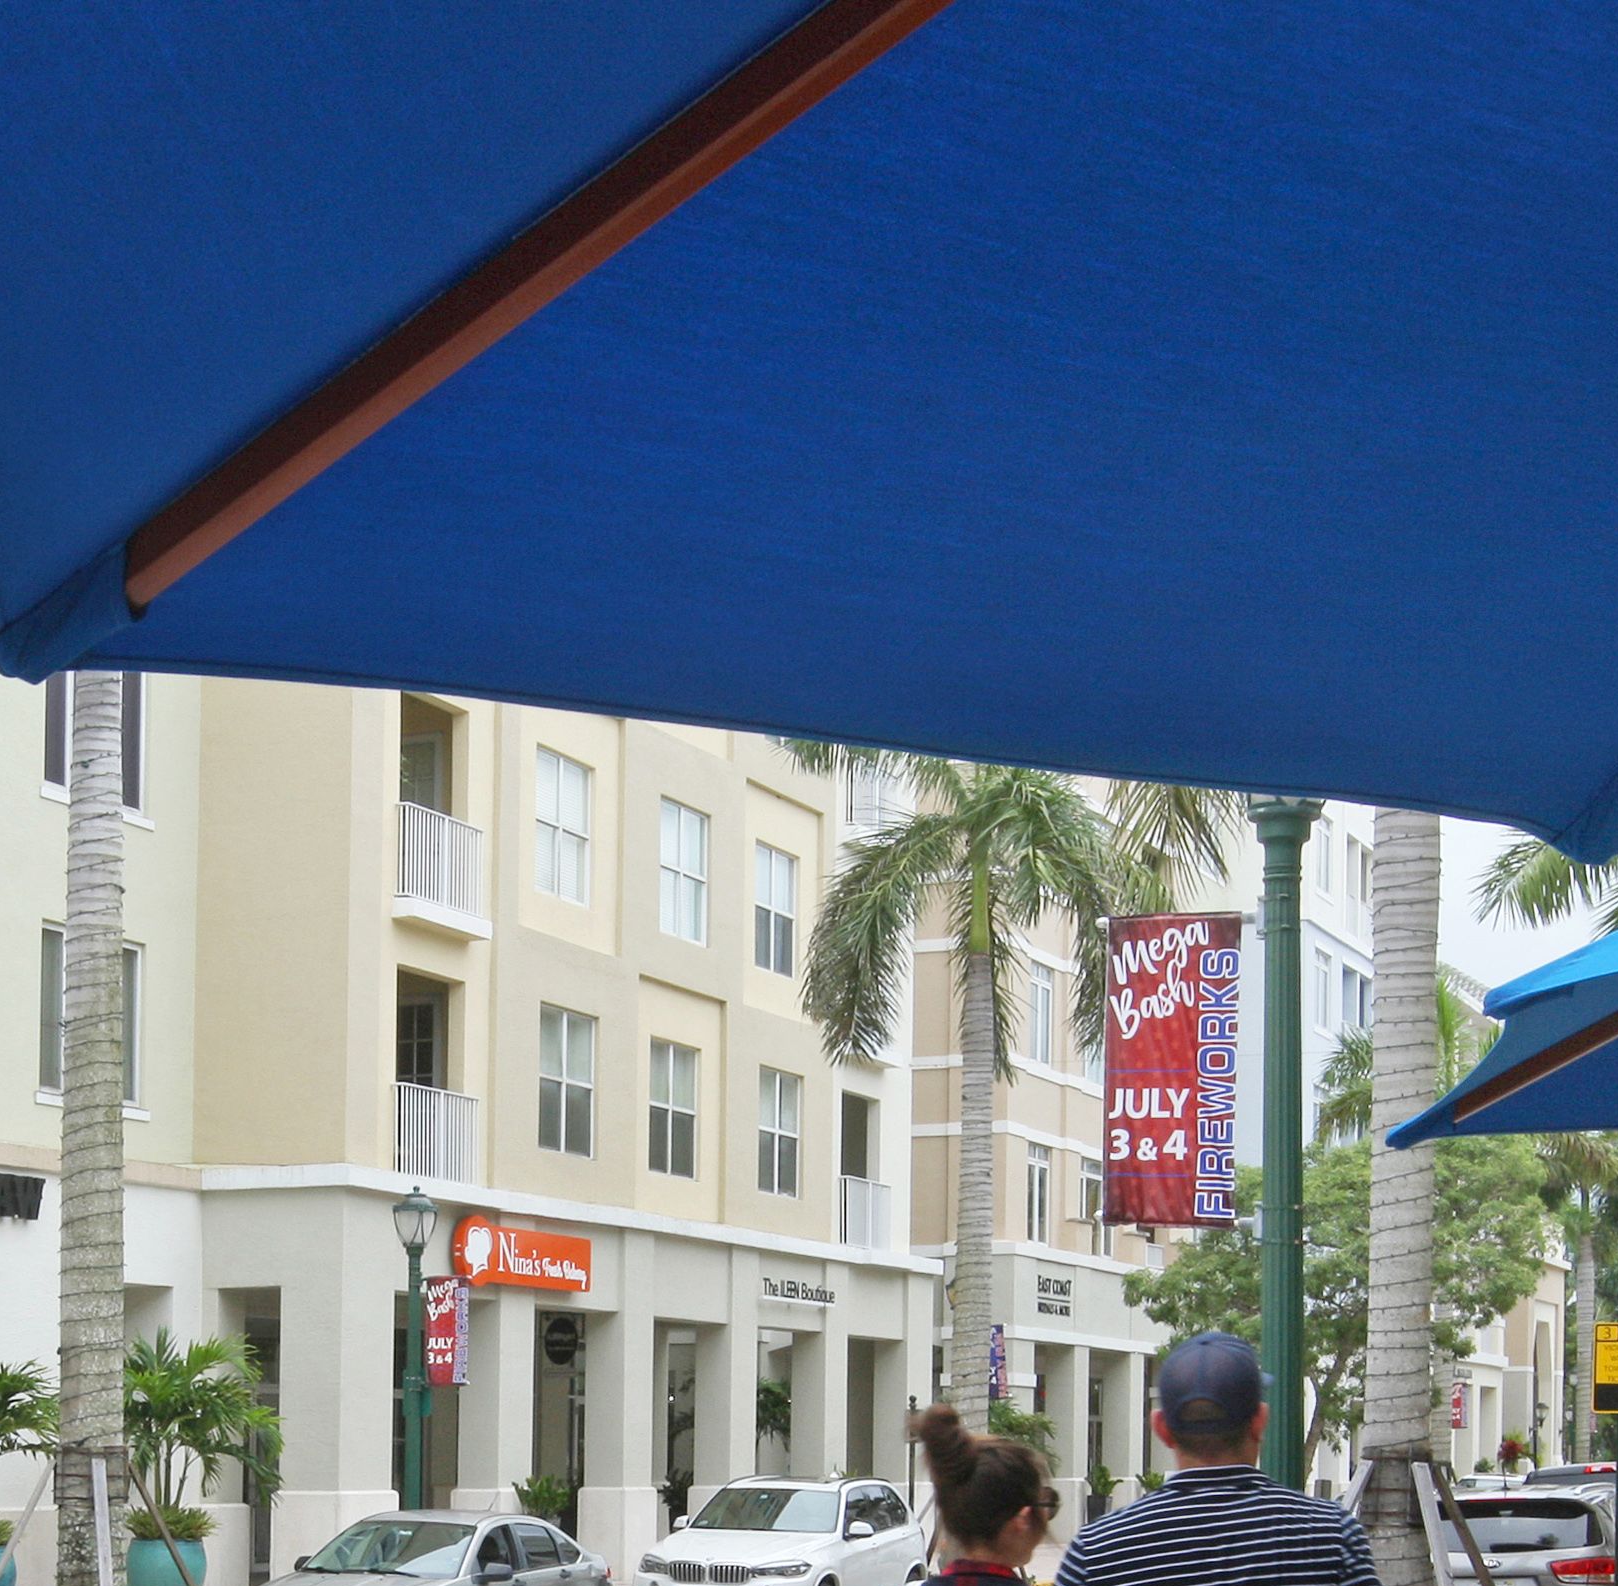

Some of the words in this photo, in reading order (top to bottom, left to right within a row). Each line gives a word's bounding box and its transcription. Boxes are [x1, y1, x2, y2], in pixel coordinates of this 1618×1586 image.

[1112, 921, 1210, 985] Mega
[1110, 958, 1195, 1040] Bash
[1194, 948, 1241, 1219] FIREWORKS
[1108, 1087, 1190, 1120] JULY
[498, 1231, 542, 1277] Nina's
[763, 1277, 779, 1297] The
[1037, 1275, 1052, 1294] EAST
[1052, 1279, 1072, 1297] COAST
[427, 1296, 455, 1322] Bash
[427, 1336, 454, 1350] JULY
